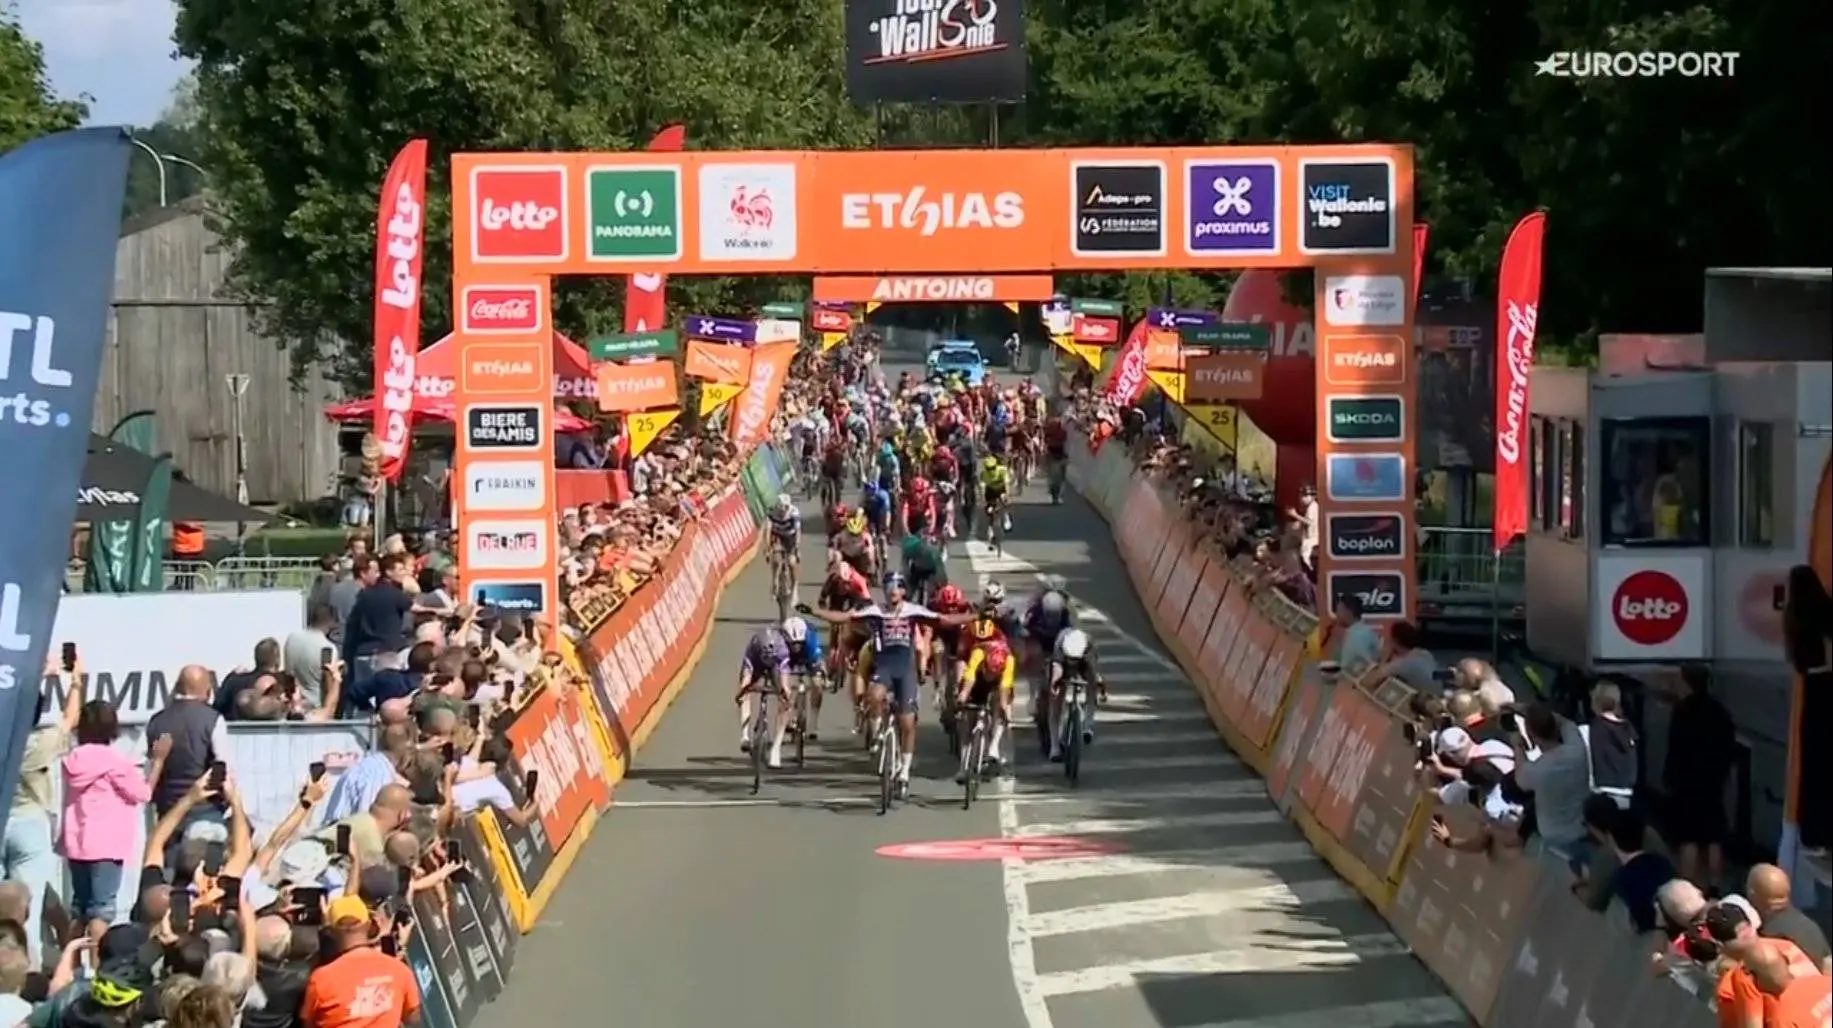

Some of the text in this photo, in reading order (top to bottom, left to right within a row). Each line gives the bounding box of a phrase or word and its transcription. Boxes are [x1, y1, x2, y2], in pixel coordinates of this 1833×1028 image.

[1309, 184, 1351, 200] VISIT
[596, 225, 673, 237] PANORAMA
[1195, 221, 1270, 237] proximus
[872, 278, 995, 299] ANTOING
[0, 311, 73, 387] TL
[0, 393, 71, 427] rts.
[1211, 409, 1231, 426] 25
[481, 412, 528, 427] BIERE
[636, 416, 655, 433] 25
[496, 427, 536, 442] AMIS
[1337, 536, 1395, 552] boplan
